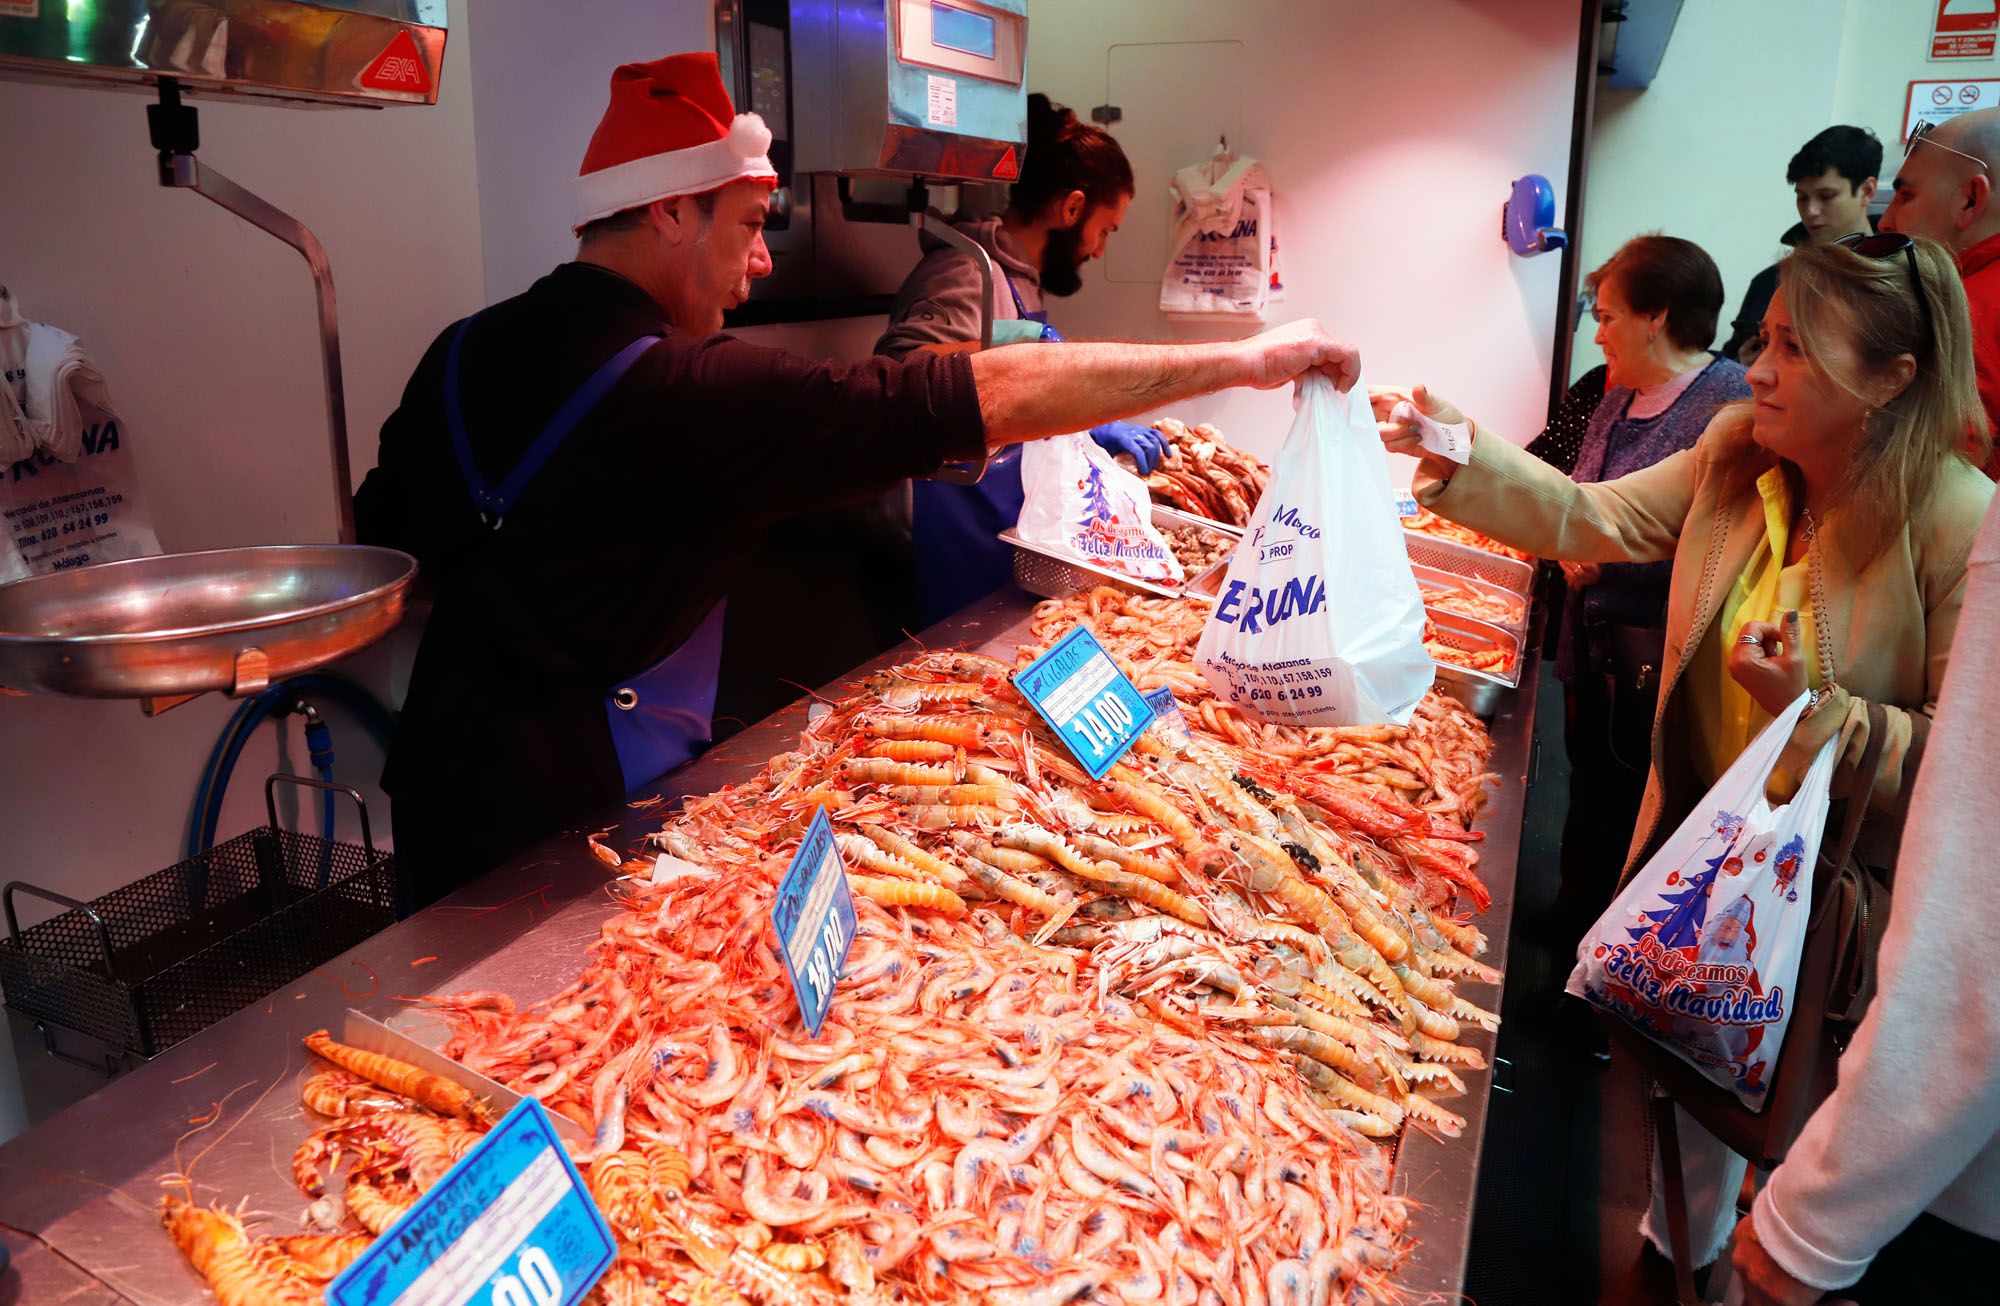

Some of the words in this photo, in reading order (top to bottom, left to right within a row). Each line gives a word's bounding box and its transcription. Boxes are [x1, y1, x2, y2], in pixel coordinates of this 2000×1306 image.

[375, 56, 421, 84] EXA
[41, 527, 58, 541] 620
[63, 522, 75, 535] 64
[79, 516, 92, 530] 24
[94, 512, 109, 526] 99
[1078, 534, 1112, 557] Feliz
[52, 553, 91, 572] Málaga
[1215, 574, 1328, 636] ERUNA
[1289, 688, 1306, 701] 24
[1307, 685, 1323, 699] 99
[1639, 934, 1663, 962] Os
[1608, 947, 1662, 1003] Feliz
[1668, 986, 1782, 1023] Navidad
